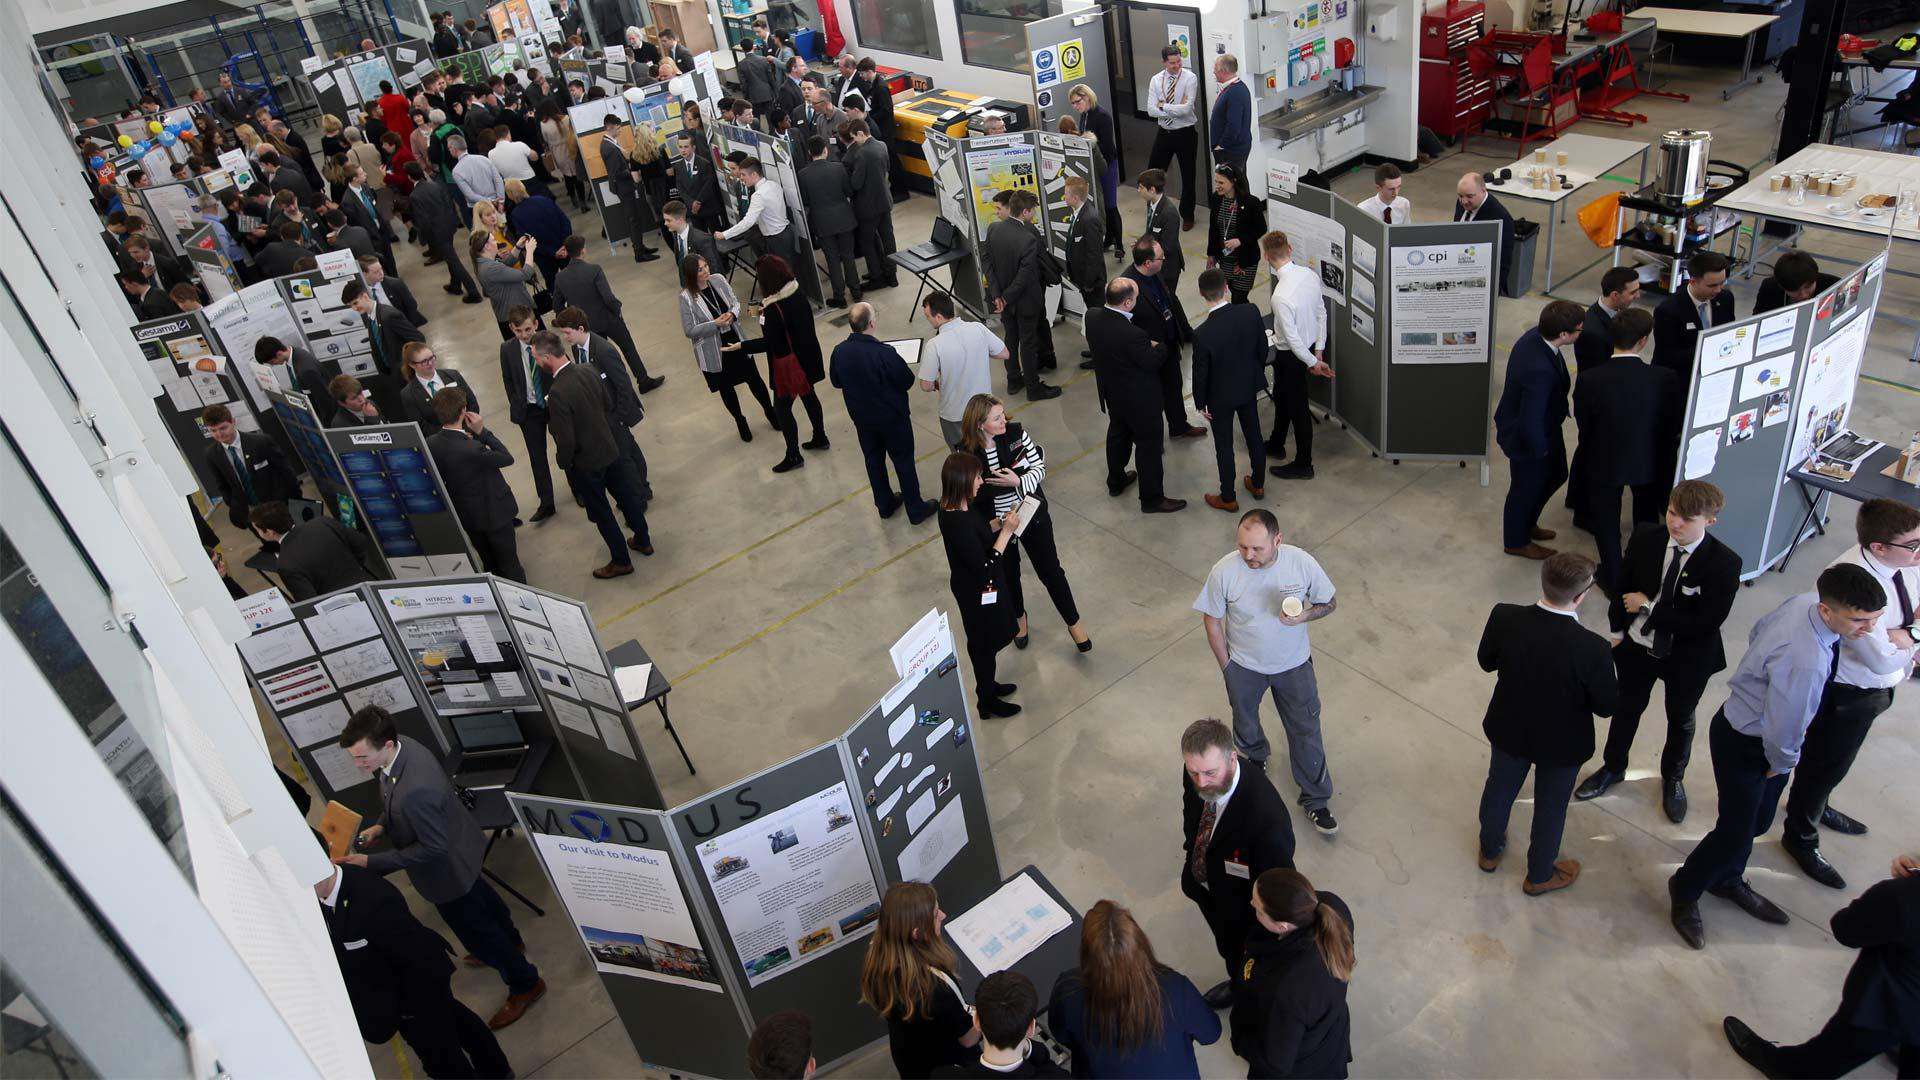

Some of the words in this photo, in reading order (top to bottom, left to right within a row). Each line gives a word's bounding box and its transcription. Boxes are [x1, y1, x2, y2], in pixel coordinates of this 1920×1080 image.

[1428, 251, 1448, 263] cpi
[137, 324, 177, 339] Gestamp
[558, 843, 579, 854] Our
[581, 846, 605, 858] Visit
[607, 851, 620, 860] to
[621, 852, 660, 867] Modus
